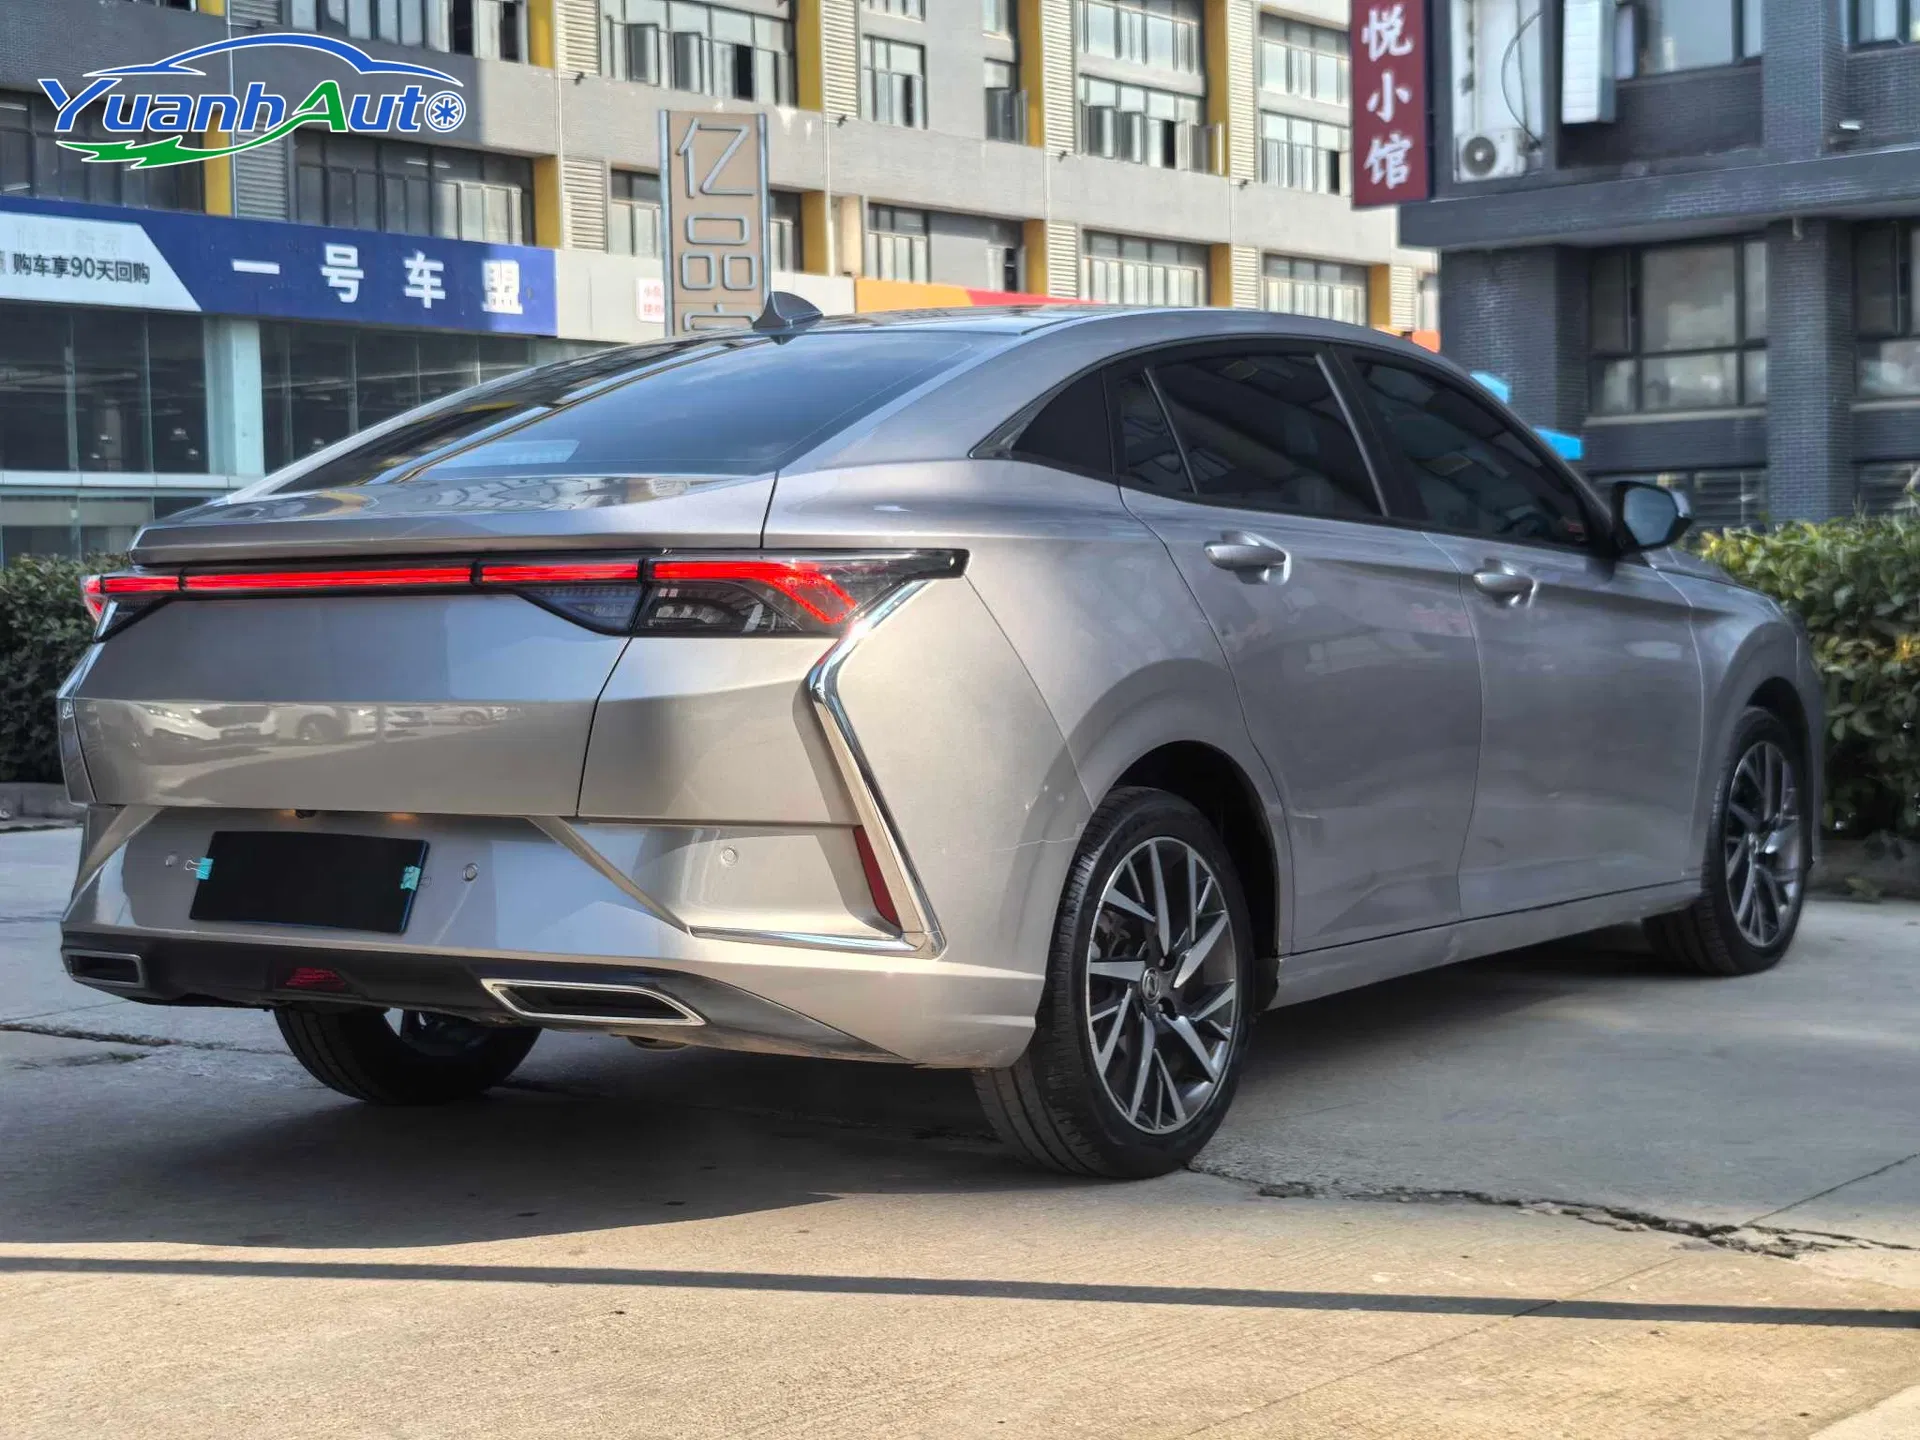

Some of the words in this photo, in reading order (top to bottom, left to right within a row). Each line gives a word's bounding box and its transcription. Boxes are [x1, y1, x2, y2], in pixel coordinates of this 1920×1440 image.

[1361, 5, 1414, 190] 悦小馆
[13, 252, 150, 285] 购车享90天回购
[231, 243, 523, 314] 一号车盟
